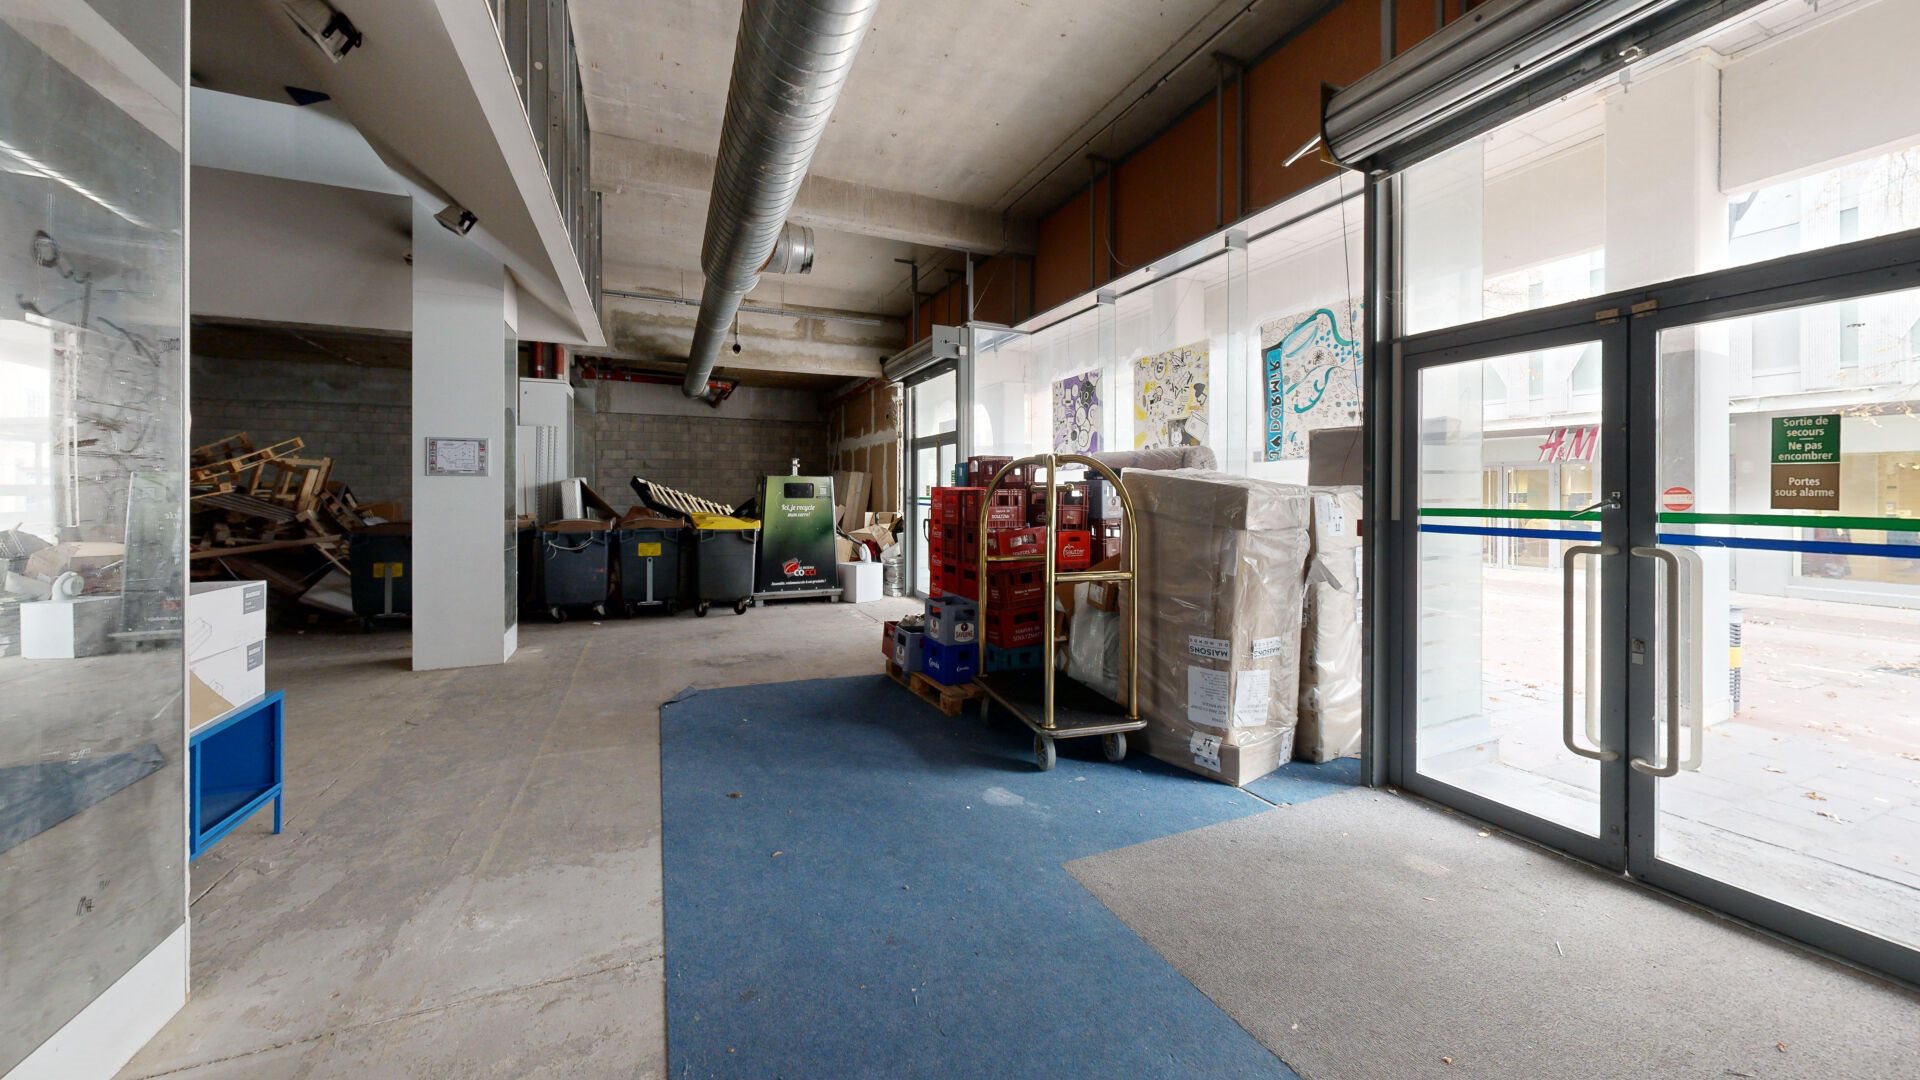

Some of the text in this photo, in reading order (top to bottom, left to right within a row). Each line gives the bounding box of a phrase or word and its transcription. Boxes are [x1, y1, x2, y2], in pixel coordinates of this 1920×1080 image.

[1783, 416, 1829, 427] Sortie de
[1786, 428, 1824, 437] secours
[1538, 426, 1600, 463] H&M
[1788, 442, 1822, 451] Ne pas
[1778, 451, 1832, 461] encombrer
[1788, 477, 1820, 486] Portes
[1775, 488, 1835, 497] sous alarme
[1189, 645, 1228, 657] MAISONS
